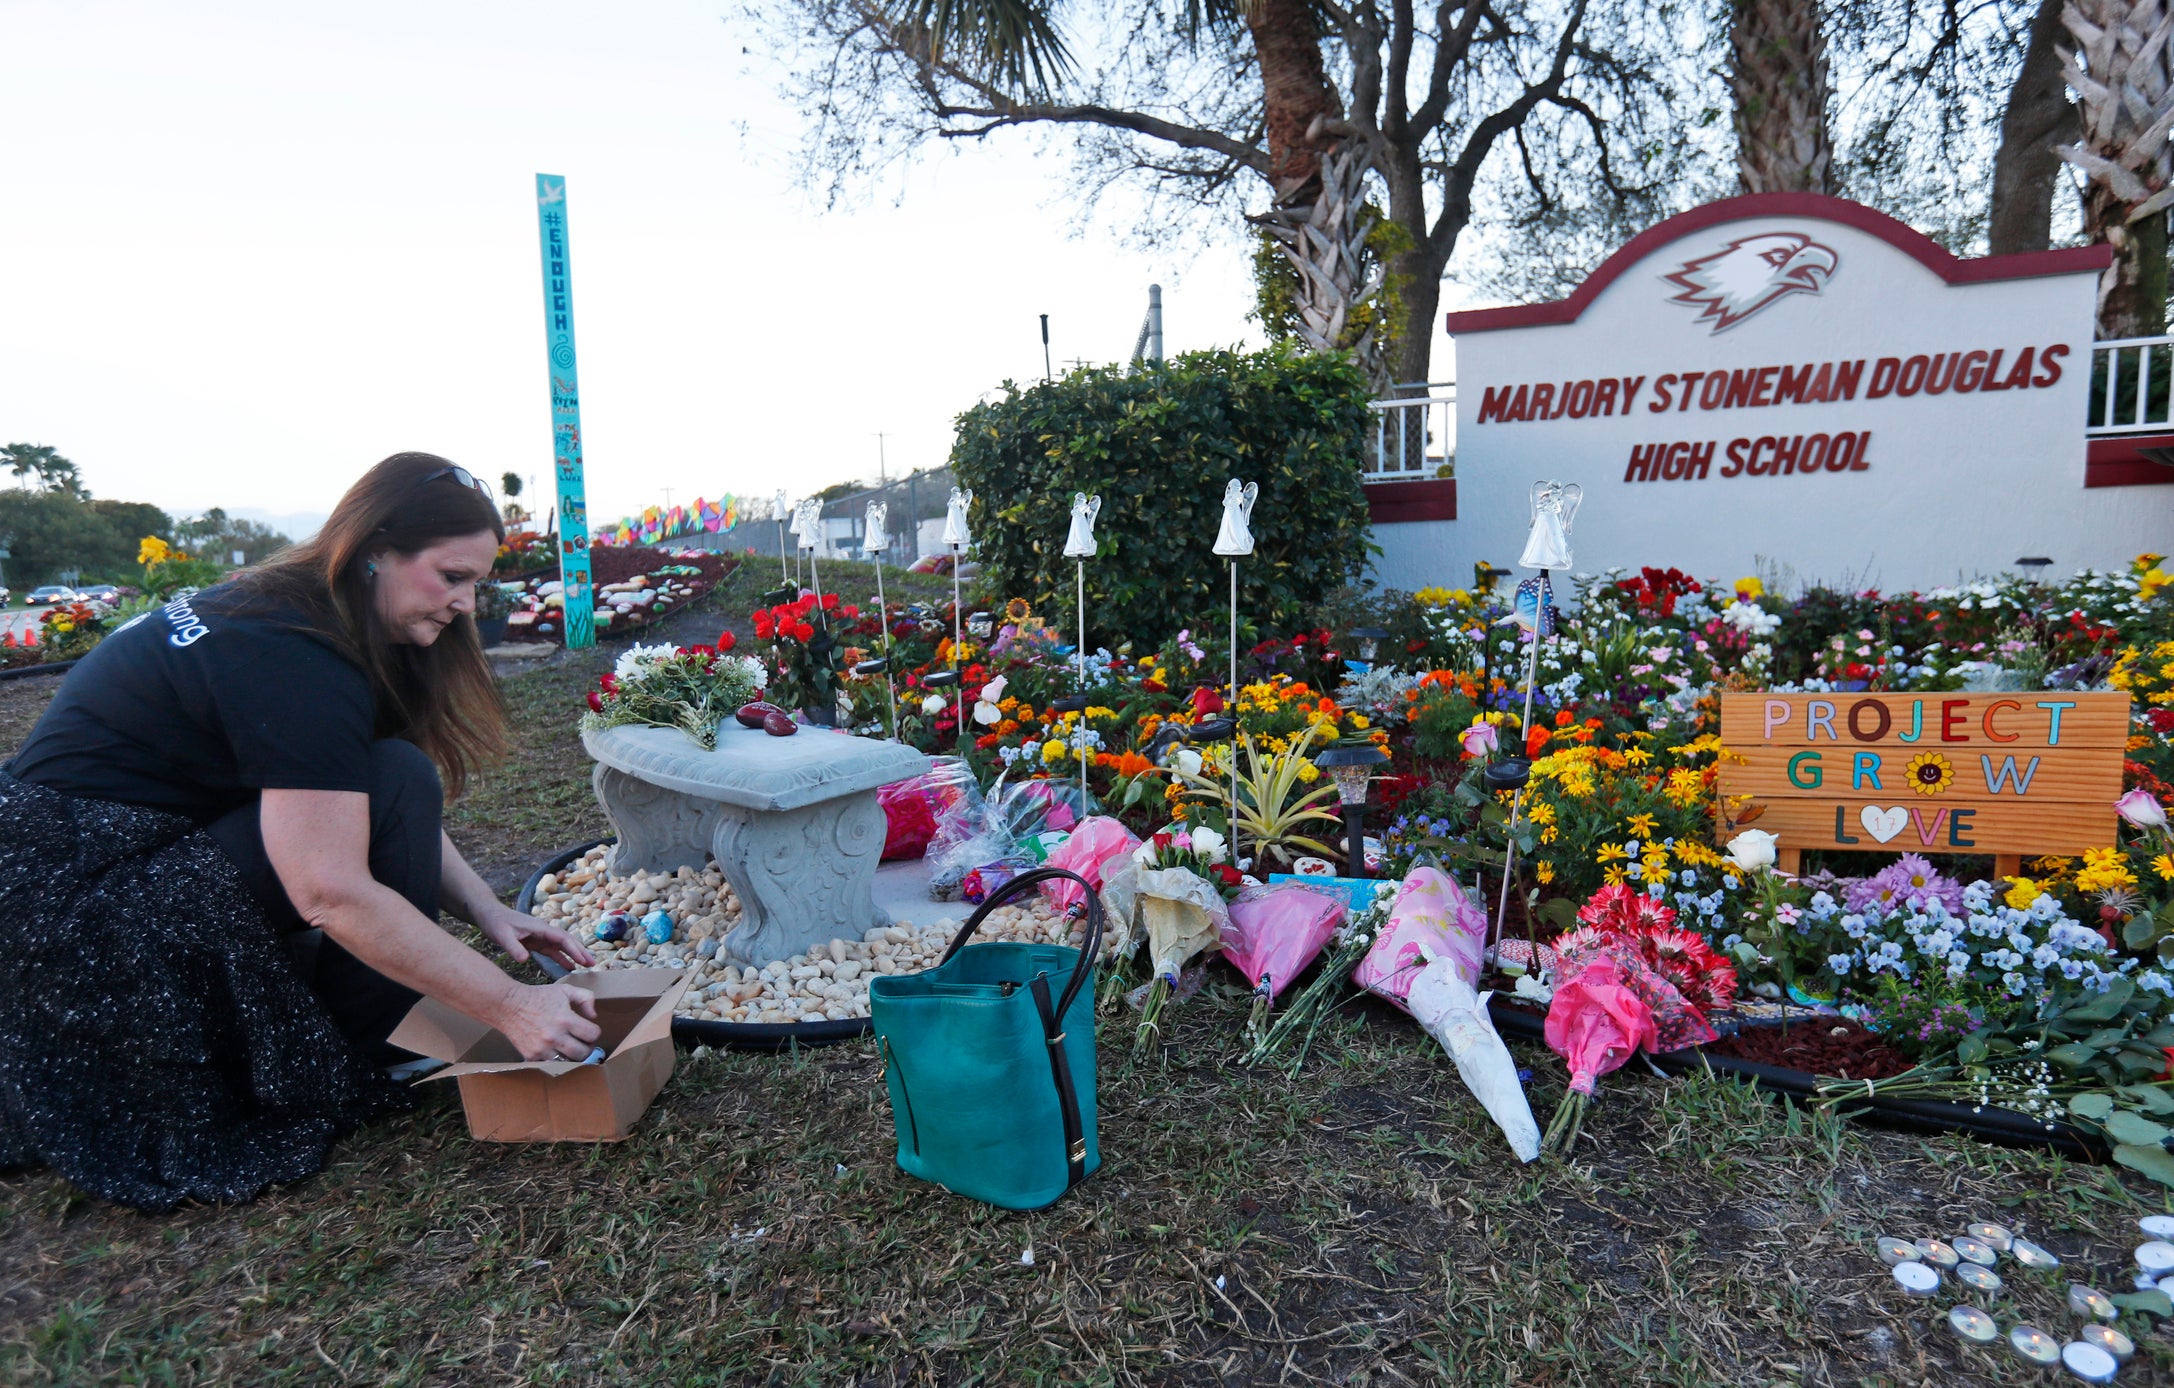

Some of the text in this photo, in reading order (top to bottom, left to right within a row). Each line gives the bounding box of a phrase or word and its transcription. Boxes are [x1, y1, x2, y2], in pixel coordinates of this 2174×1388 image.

[544, 211, 568, 331] #ENOUGH
[1476, 344, 2070, 424] MARJORY STONEMAN DOUGLAS
[1623, 431, 1872, 483] HIGH SCHOOL
[164, 592, 211, 647] trong
[1764, 699, 2076, 745] PROJECT
